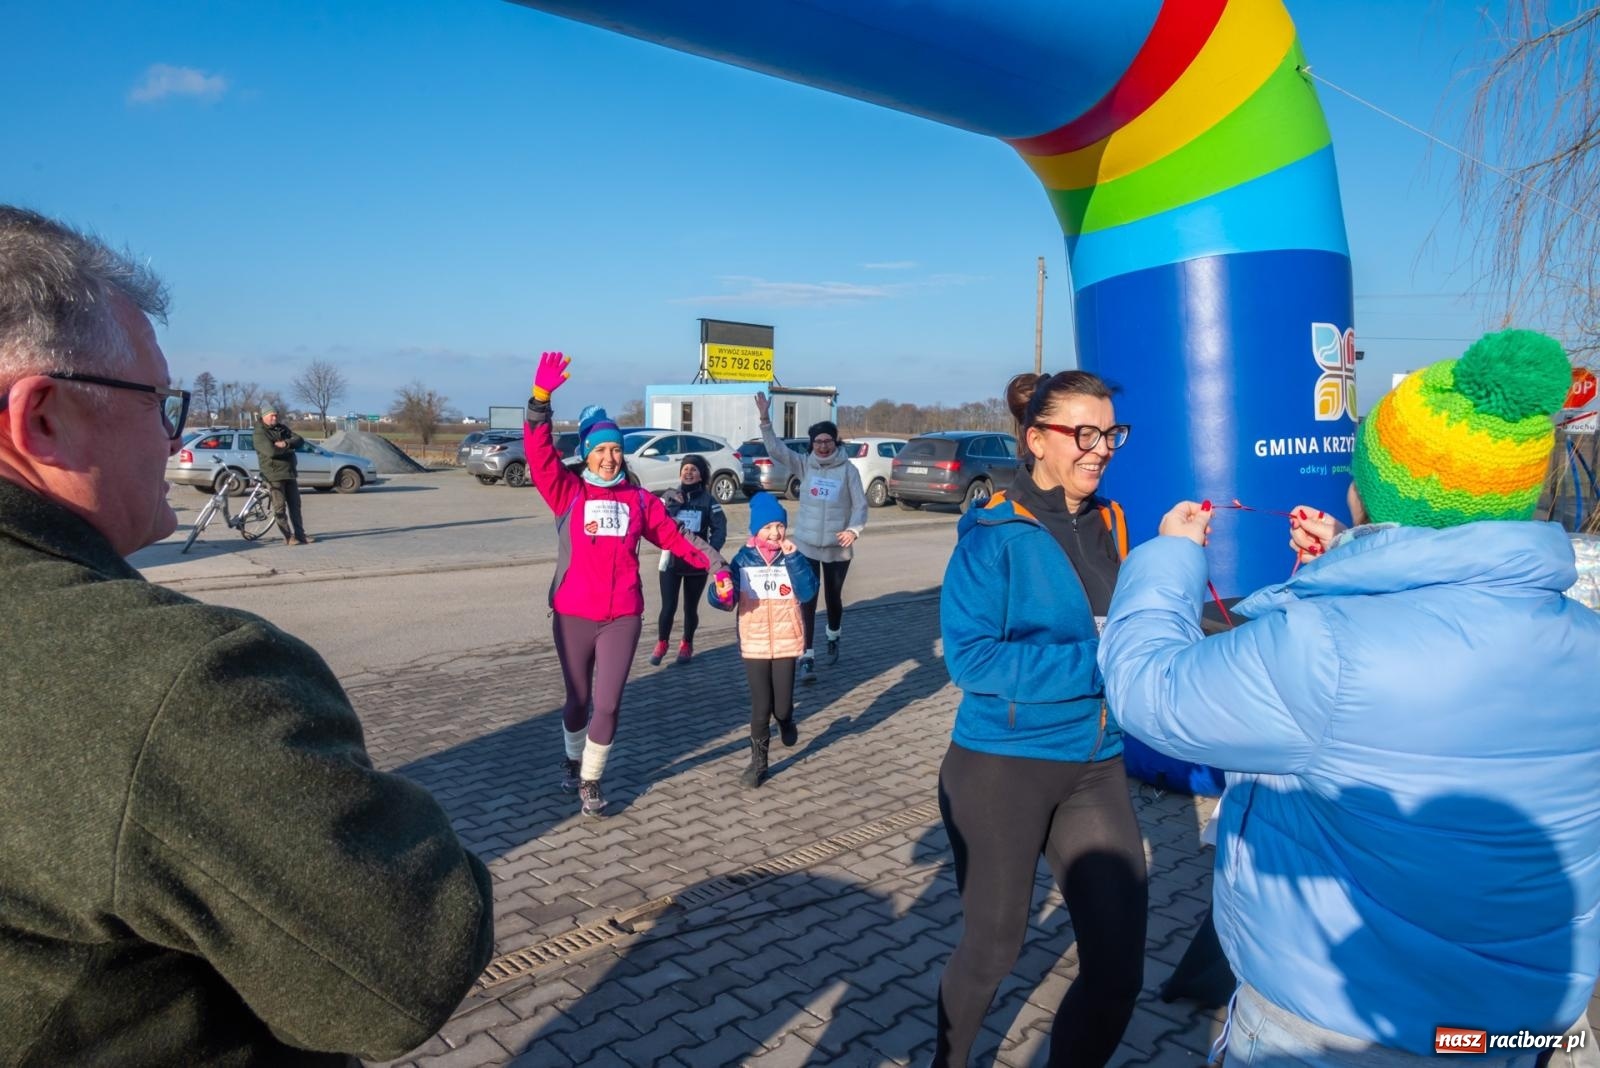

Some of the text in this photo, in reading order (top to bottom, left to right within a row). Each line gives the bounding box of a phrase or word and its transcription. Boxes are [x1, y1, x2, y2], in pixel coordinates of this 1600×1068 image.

[708, 356, 772, 371] 575 792 626
[1572, 381, 1593, 395] OP
[1254, 432, 1356, 458] GMINA KRZYŻ
[1299, 464, 1352, 476] odkryj pozna
[599, 516, 621, 529] 133
[763, 580, 777, 592] 60
